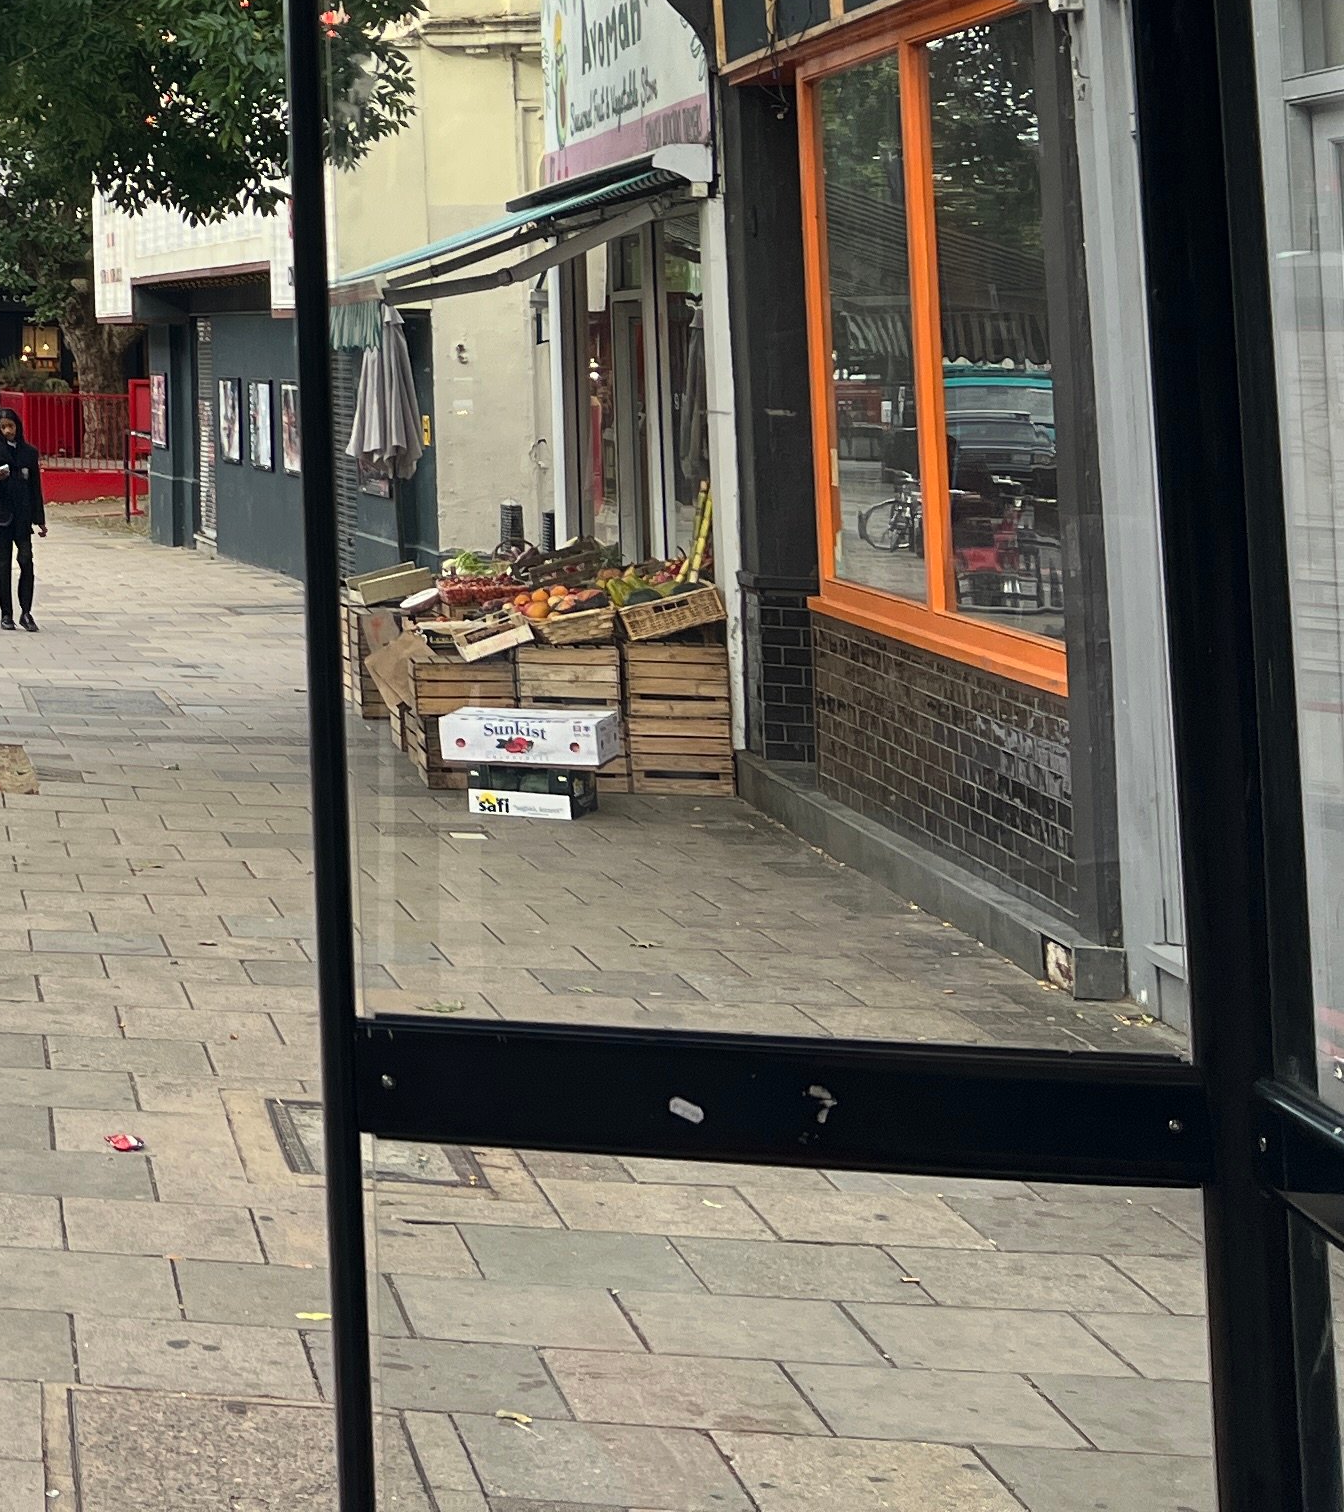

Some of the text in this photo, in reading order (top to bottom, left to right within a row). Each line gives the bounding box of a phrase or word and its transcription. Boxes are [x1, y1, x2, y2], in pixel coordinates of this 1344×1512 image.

[13, 292, 27, 303] CA
[483, 721, 547, 741] Sunkist
[478, 797, 510, 814] safi
